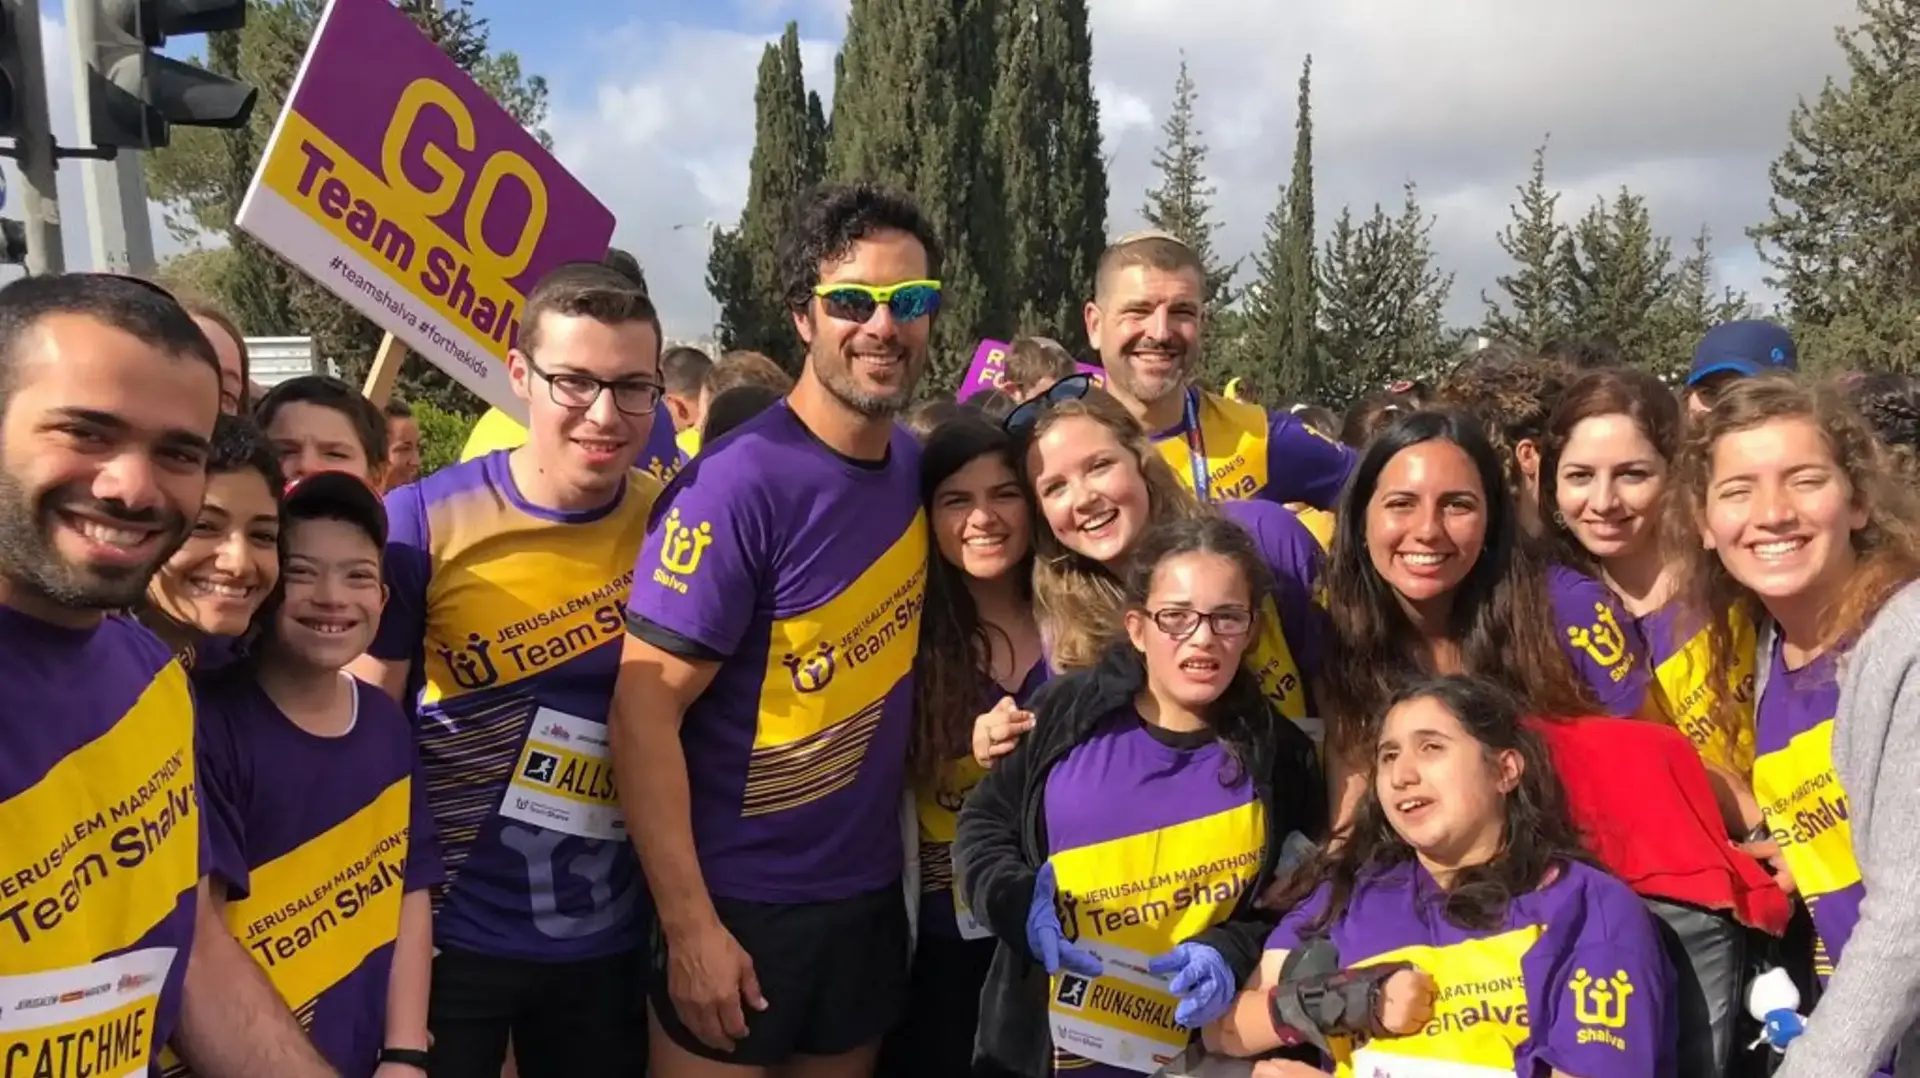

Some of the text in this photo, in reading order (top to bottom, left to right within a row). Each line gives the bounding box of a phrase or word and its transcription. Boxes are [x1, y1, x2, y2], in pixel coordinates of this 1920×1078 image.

[296, 138, 416, 272] Team
[381, 77, 548, 280] GO
[329, 255, 488, 379] #teamshalva #forthekids
[496, 595, 591, 643] JERUSALEM
[502, 622, 597, 672] Team
[556, 757, 618, 801] ALLS
[0, 812, 107, 899] ERUSALEM
[0, 853, 108, 944] Team
[246, 881, 333, 939] JERUSALEM
[1083, 873, 1171, 904] JERUSALEM
[251, 909, 338, 967] Team
[1086, 900, 1170, 937] Team
[4, 1007, 147, 1078] CATCHME
